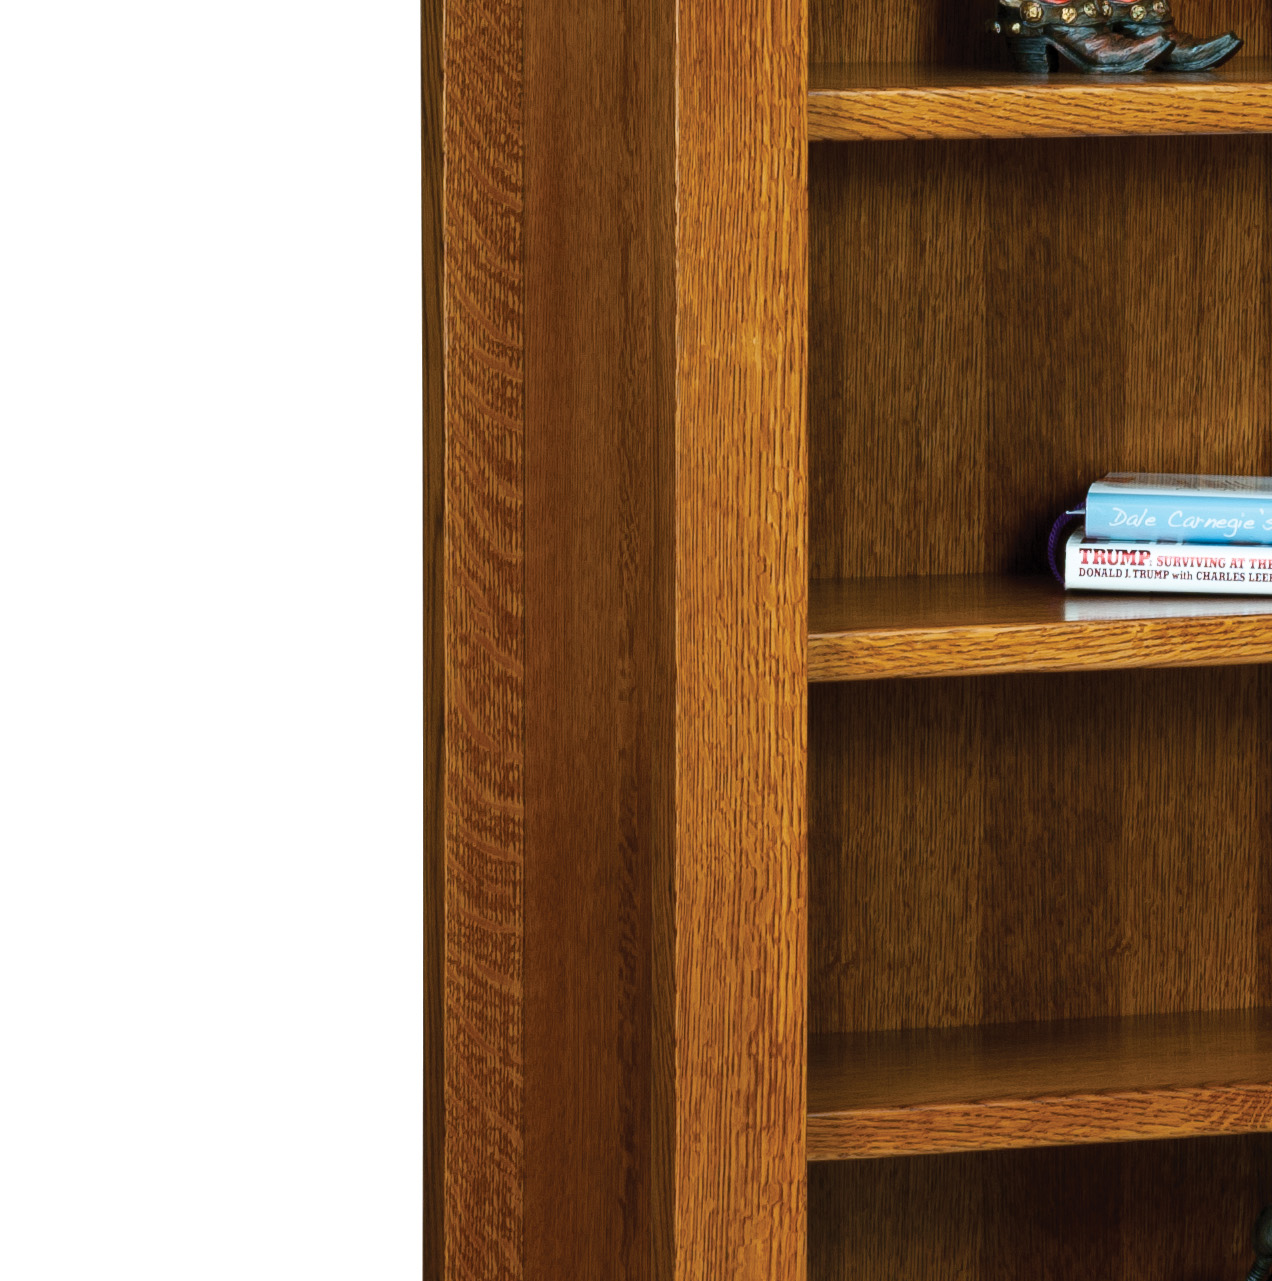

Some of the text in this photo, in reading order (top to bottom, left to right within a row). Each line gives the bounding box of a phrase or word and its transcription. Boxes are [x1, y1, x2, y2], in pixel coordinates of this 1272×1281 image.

[1109, 507, 1156, 528] Dale
[1156, 556, 1226, 569] SURVIVING
[1229, 558, 1246, 569] AT
[1078, 568, 1122, 578] DONALD
[1124, 569, 1131, 579] J.
[1132, 569, 1170, 580] TRUMP
[1172, 571, 1193, 580] with
[1196, 572, 1245, 582] CHARLES
